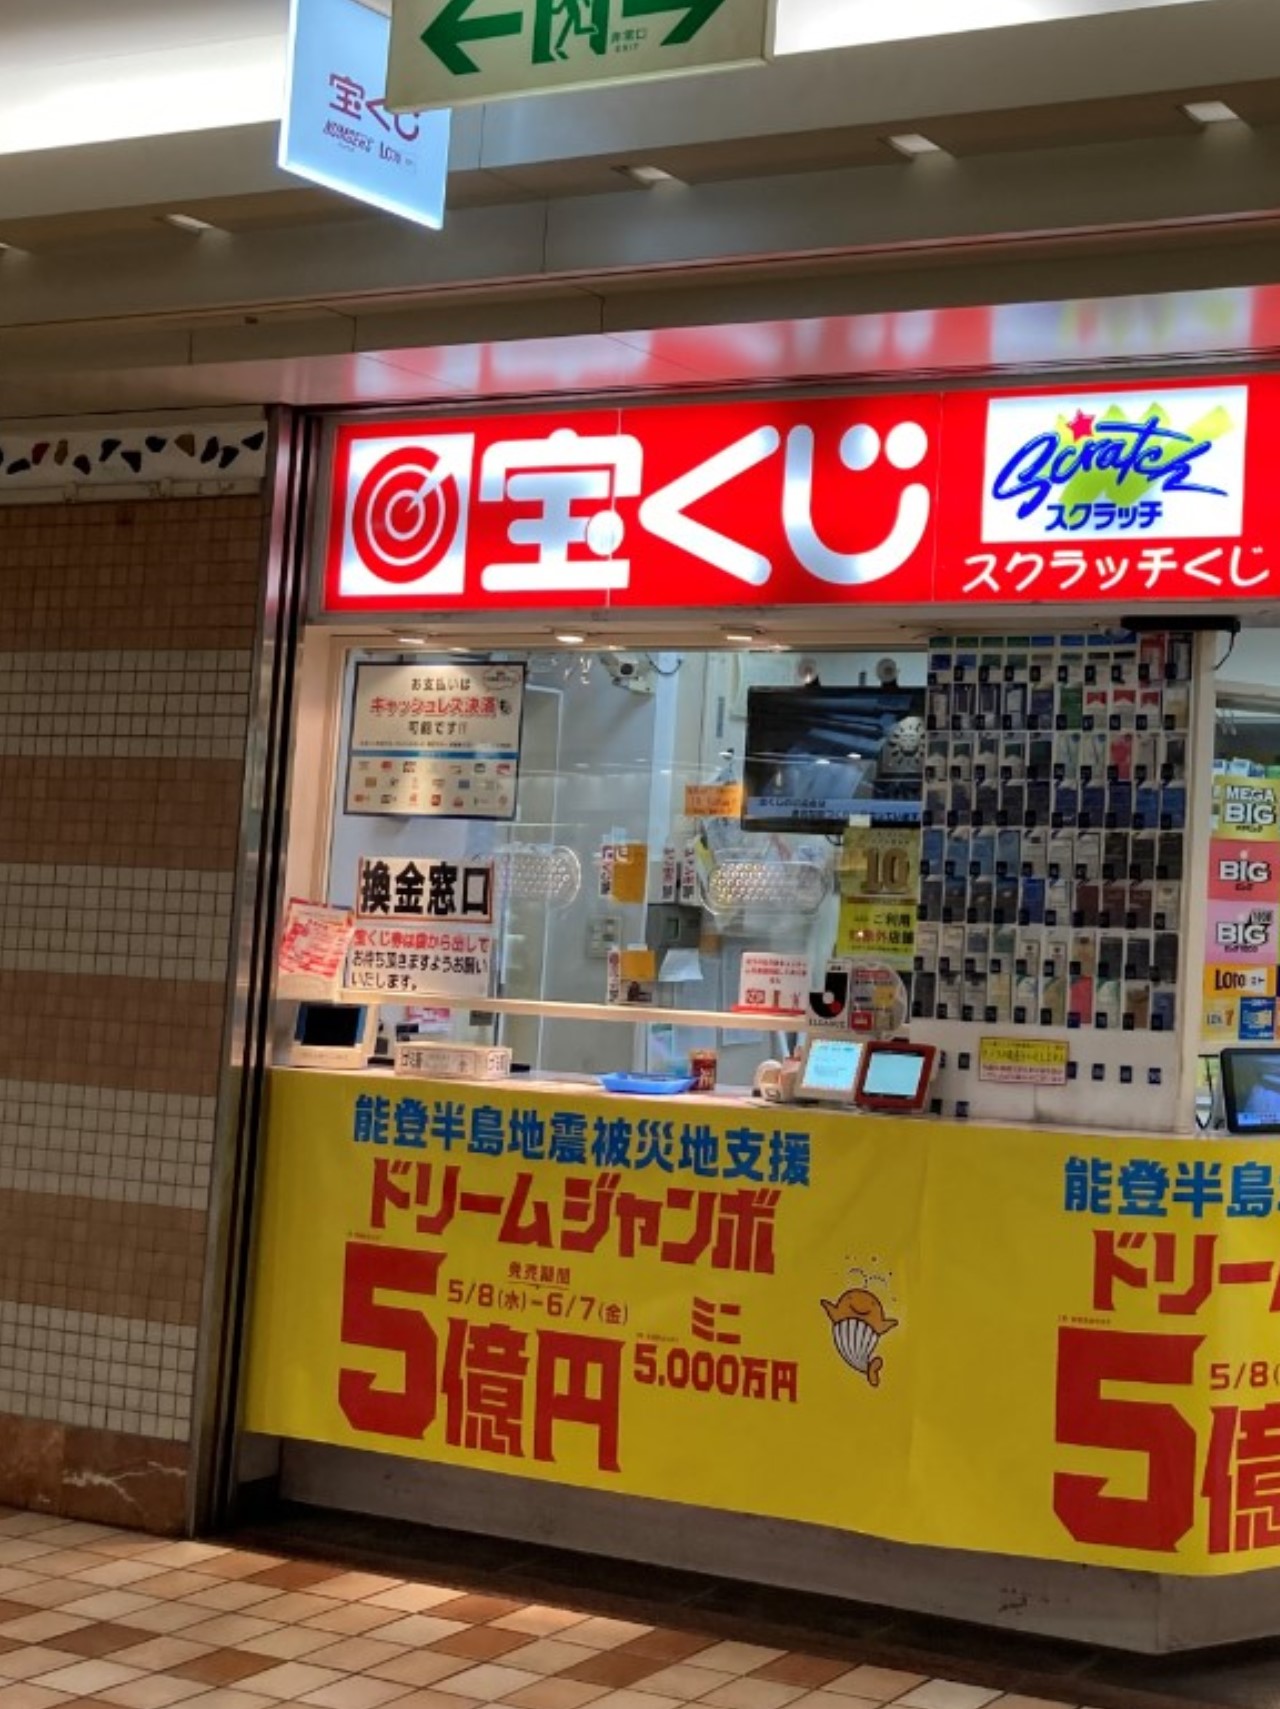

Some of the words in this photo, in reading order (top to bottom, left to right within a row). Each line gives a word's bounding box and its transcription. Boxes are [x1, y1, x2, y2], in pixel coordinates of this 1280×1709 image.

[478, 421, 931, 593] 宝くじ
[1045, 499, 1165, 533] スクラッチ
[963, 545, 1271, 594] スクラッチくじ
[361, 861, 493, 917] 換金窓口
[1219, 860, 1272, 883] BIG
[353, 1093, 812, 1187] 能登半島地震被災地支援
[371, 1158, 781, 1275] ドリームジャンボ
[508, 1261, 570, 1284] 発売期間
[691, 1297, 741, 1345] ミニ
[338, 1241, 625, 1473] 5億円
